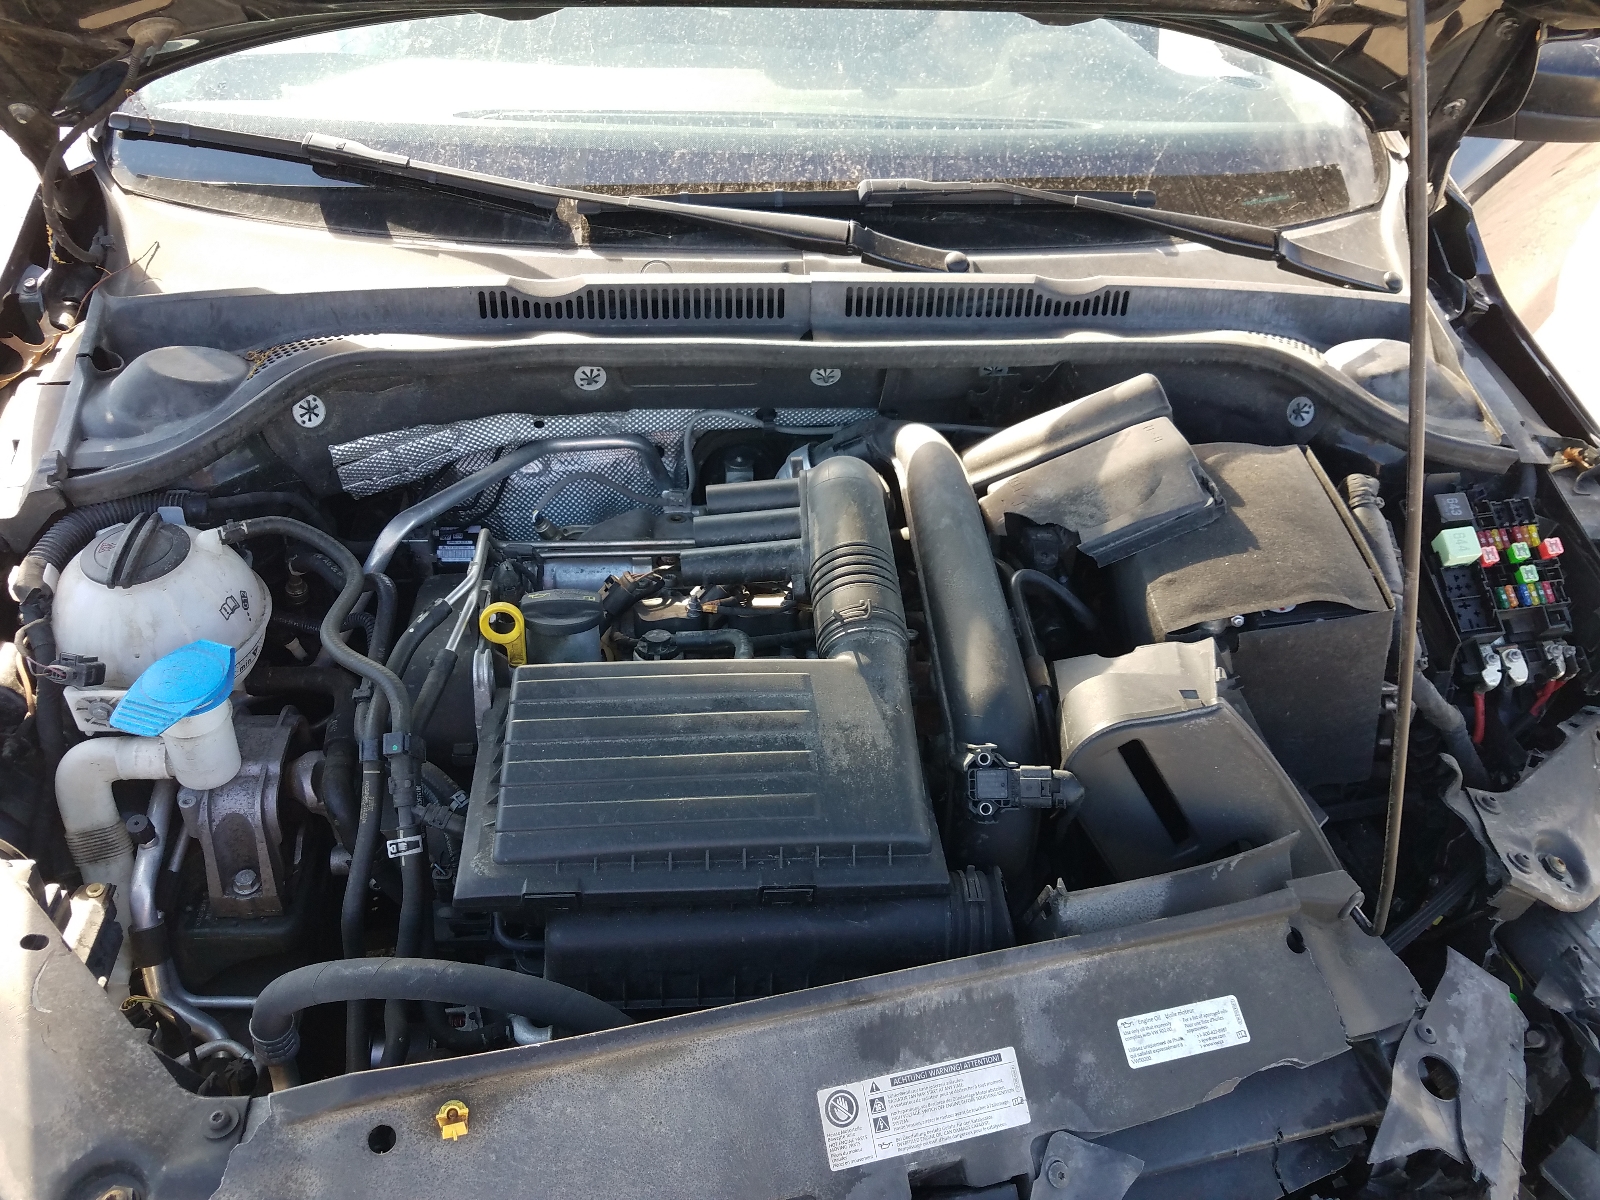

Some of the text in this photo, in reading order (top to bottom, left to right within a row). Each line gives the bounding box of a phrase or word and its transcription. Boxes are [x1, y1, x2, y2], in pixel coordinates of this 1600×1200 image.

[1446, 498, 1462, 516] 643
[239, 658, 252, 672] min
[1137, 1016, 1154, 1026] Engine
[893, 1054, 1000, 1085] ACHTUNG! WARNING! ATTENTION!
